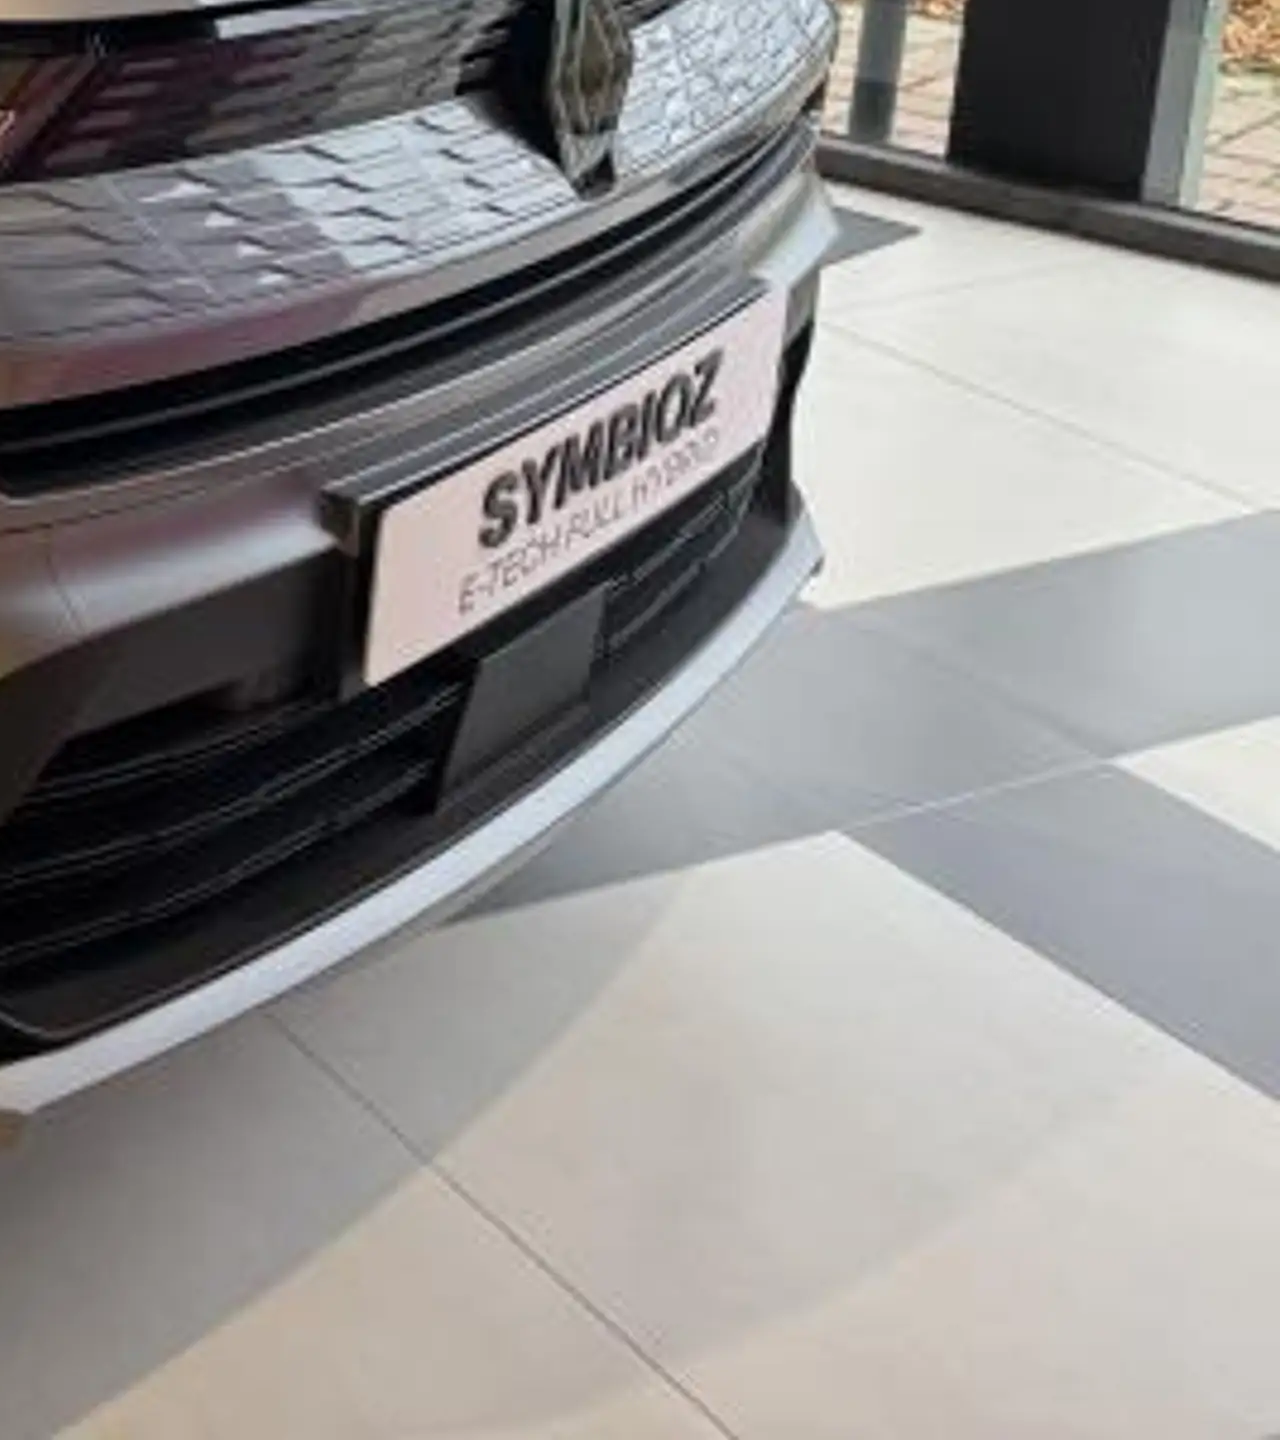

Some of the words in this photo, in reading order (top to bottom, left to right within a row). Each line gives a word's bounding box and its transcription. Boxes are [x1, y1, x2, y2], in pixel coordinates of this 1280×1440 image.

[477, 347, 725, 549] SYMBIOZ
[458, 523, 562, 615] E-TECH
[565, 488, 621, 551] FULL
